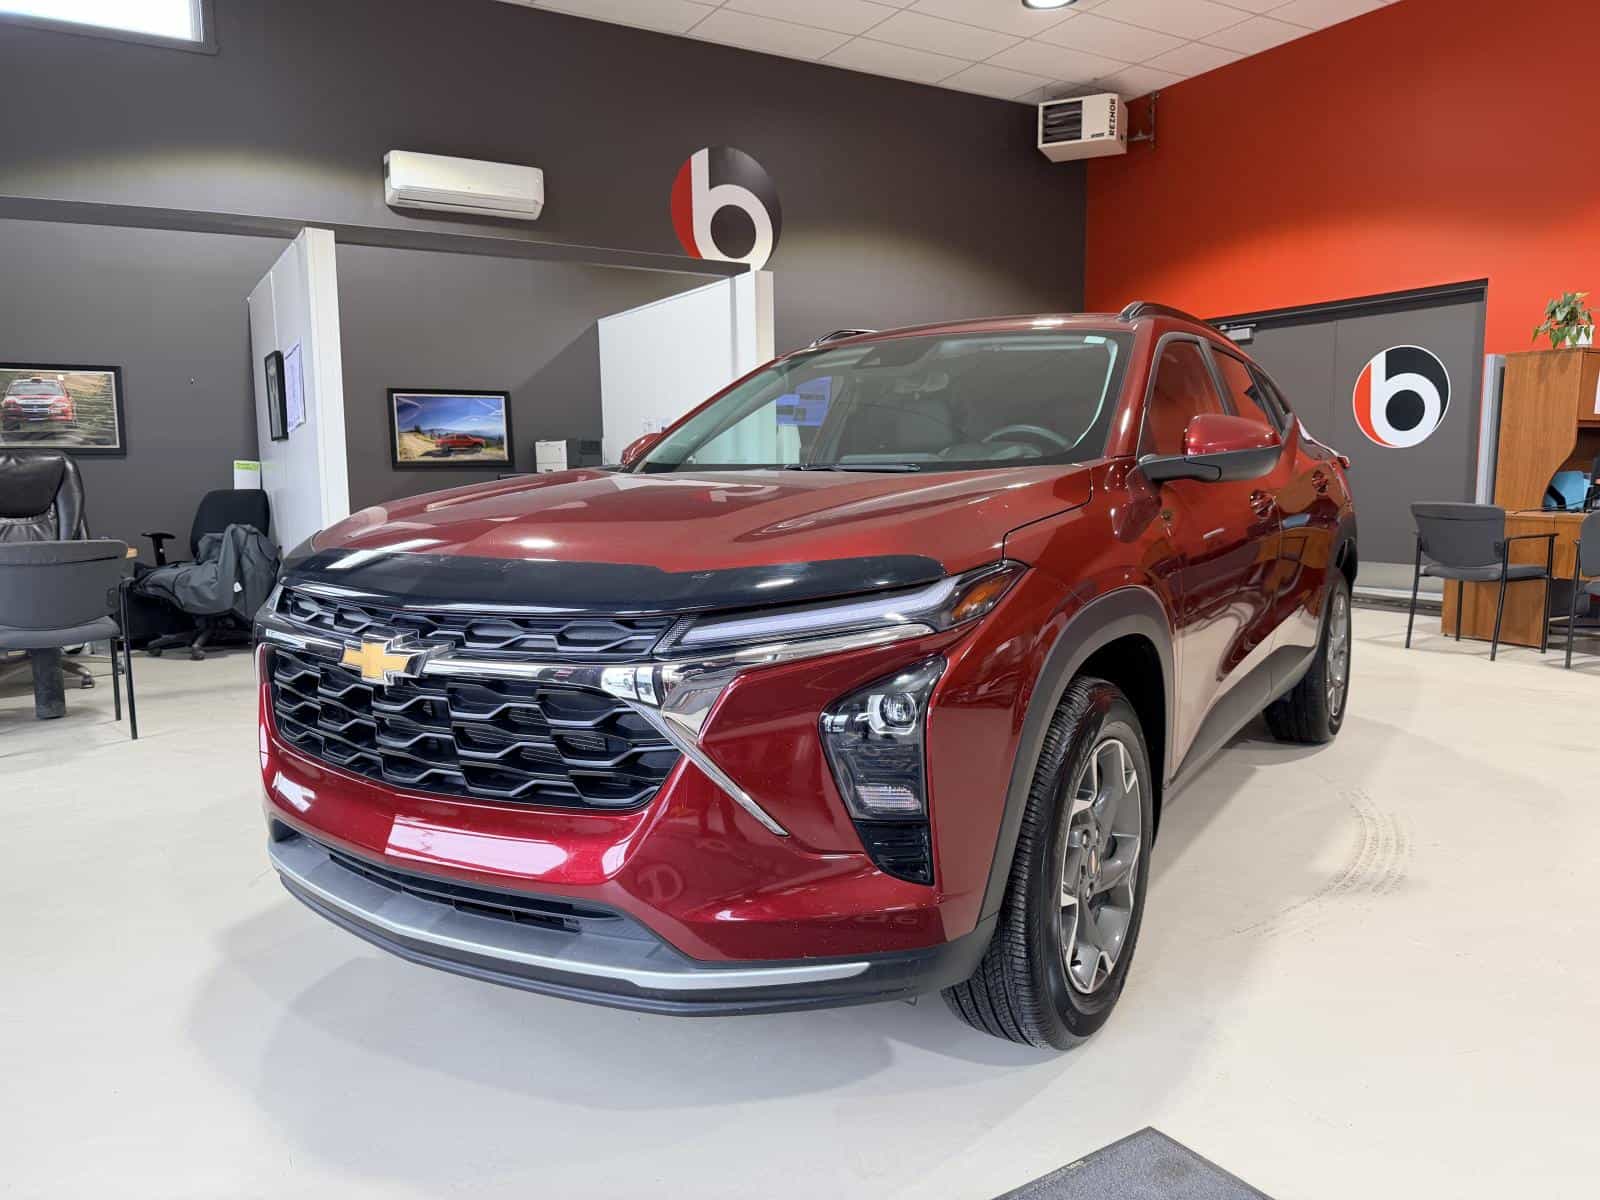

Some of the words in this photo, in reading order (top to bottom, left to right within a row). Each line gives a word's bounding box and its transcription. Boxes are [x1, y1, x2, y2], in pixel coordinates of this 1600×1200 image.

[1108, 98, 1117, 136] REZNOR
[690, 147, 773, 270] b
[1370, 350, 1441, 447] b
